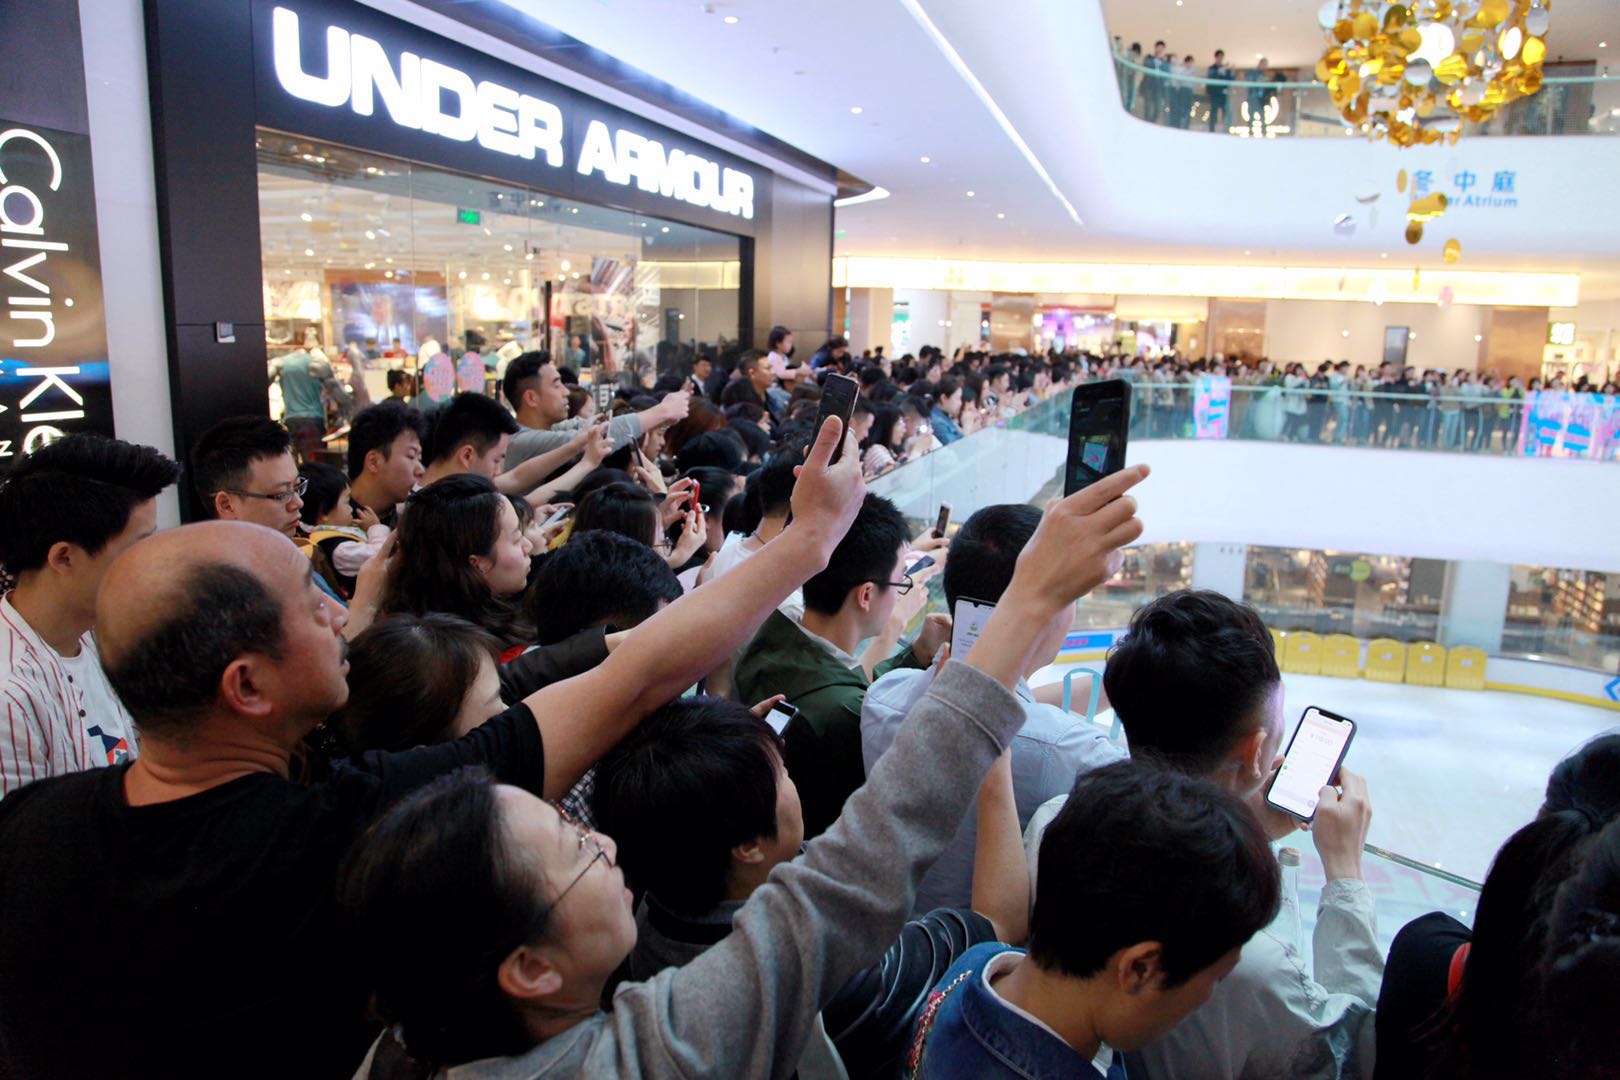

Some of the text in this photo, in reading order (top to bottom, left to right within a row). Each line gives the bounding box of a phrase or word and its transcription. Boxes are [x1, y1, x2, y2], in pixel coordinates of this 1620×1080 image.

[272, 7, 755, 218] UNDER ARMOUR
[1463, 195, 1519, 207] Atrium
[0, 129, 74, 347] Calvin
